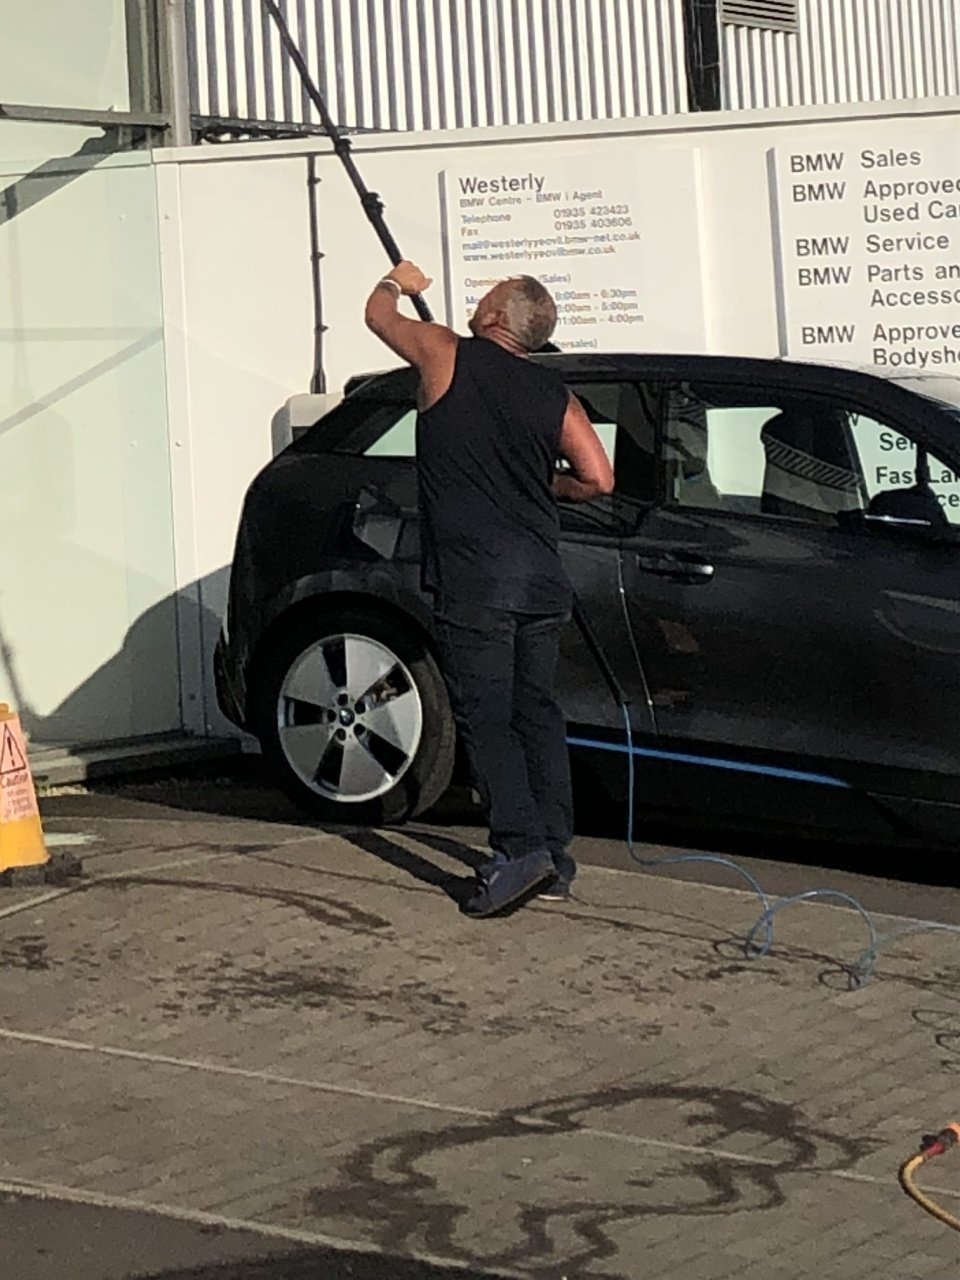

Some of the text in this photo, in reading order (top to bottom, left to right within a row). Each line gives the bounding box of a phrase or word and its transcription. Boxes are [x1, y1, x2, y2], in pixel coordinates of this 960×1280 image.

[790, 148, 921, 173] BMW Sales
[459, 173, 545, 195] Westerly
[792, 181, 846, 202] BMW
[459, 196, 485, 208] BMW
[488, 195, 522, 207] Centre
[535, 191, 562, 203] BMW
[572, 189, 603, 202] Agent
[461, 212, 512, 225] Telephone
[553, 207, 586, 219] 01935
[863, 200, 960, 223] Used Ca
[461, 227, 479, 237] Fax
[554, 219, 587, 231] 01935
[795, 232, 949, 257] BMW Service
[798, 266, 851, 286] BMW
[867, 264, 924, 283] Parts
[801, 324, 855, 345] BMW
[873, 345, 960, 369] Bodysh
[876, 466, 914, 484] Fas
